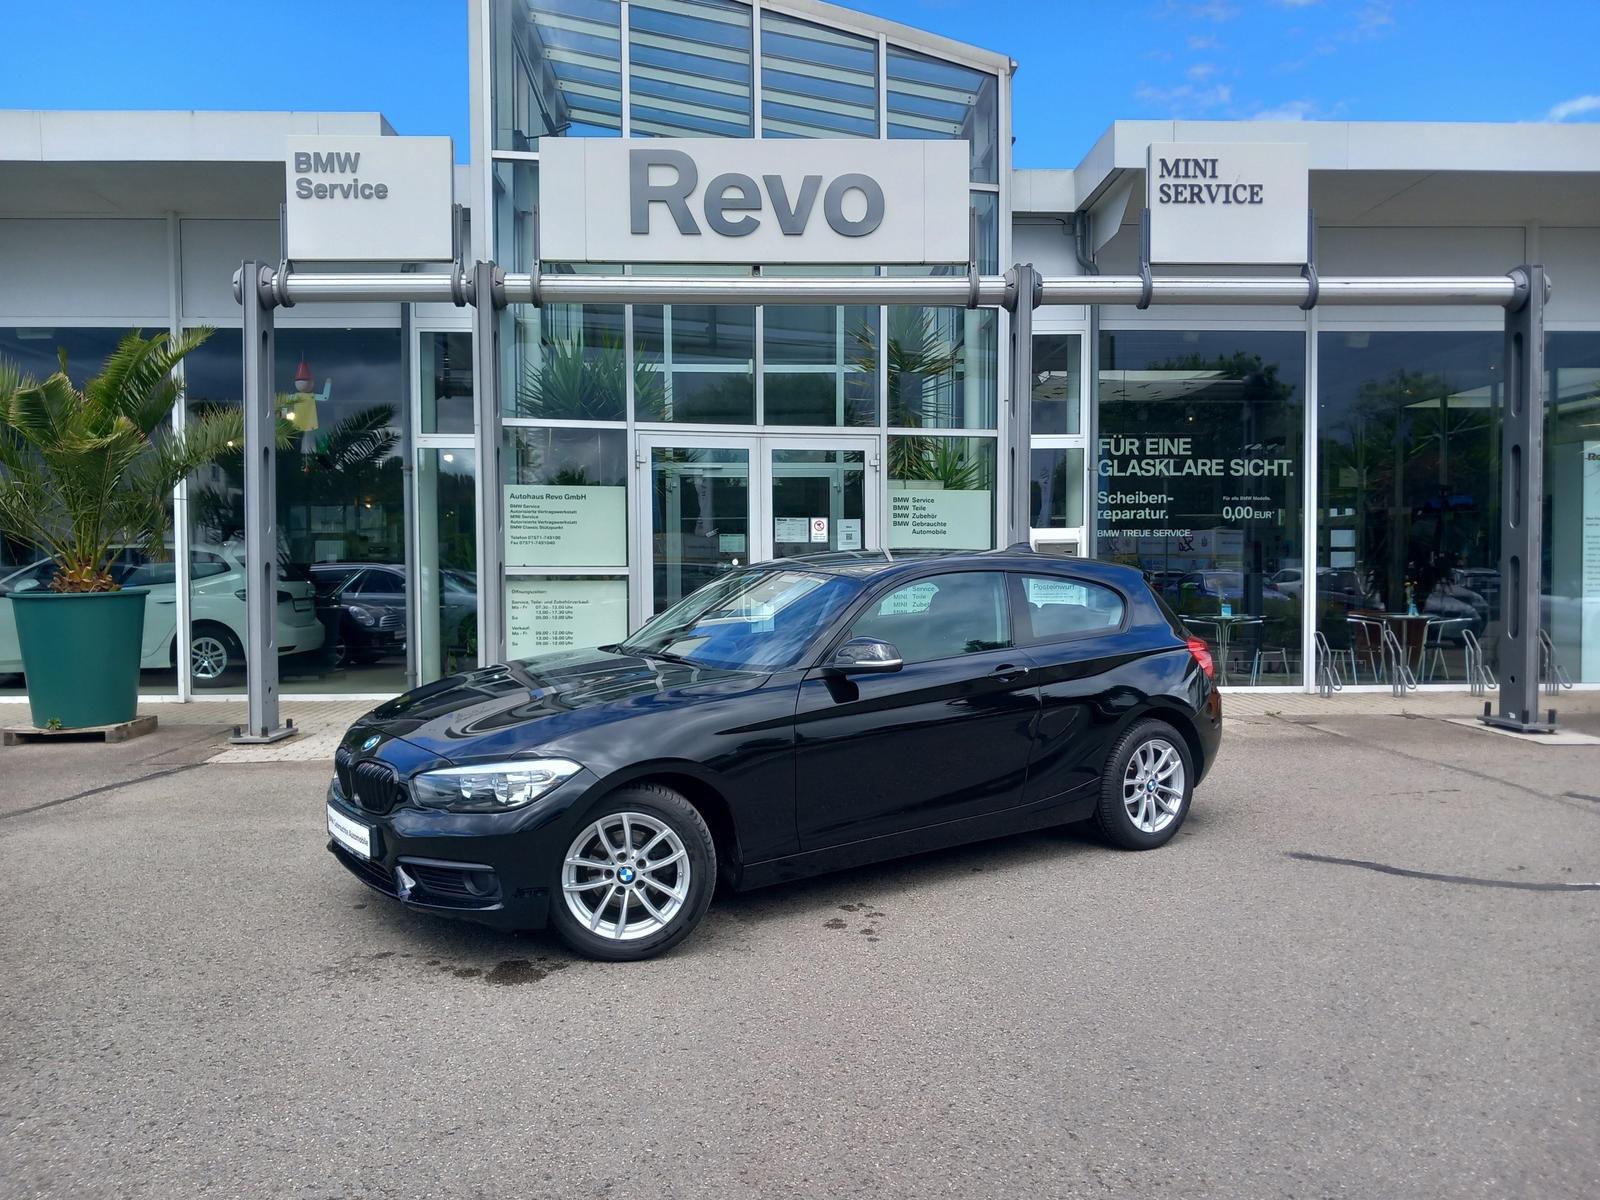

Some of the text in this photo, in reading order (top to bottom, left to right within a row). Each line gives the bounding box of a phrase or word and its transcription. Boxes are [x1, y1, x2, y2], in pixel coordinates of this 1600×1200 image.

[294, 152, 360, 173] BMW
[1159, 158, 1218, 179] MINI
[296, 177, 388, 199] Service
[629, 149, 885, 237] Revo
[1159, 183, 1264, 204] SERVICE
[1098, 434, 1192, 456] FÜR EINE
[1098, 458, 1294, 477] GLASKLARE SICHT.
[1097, 491, 1174, 504] Scheiben-
[1097, 507, 1169, 522] reparatur.
[1222, 505, 1253, 522] 0,00
[1097, 529, 1193, 538] BMW TREUE SERVICE.
